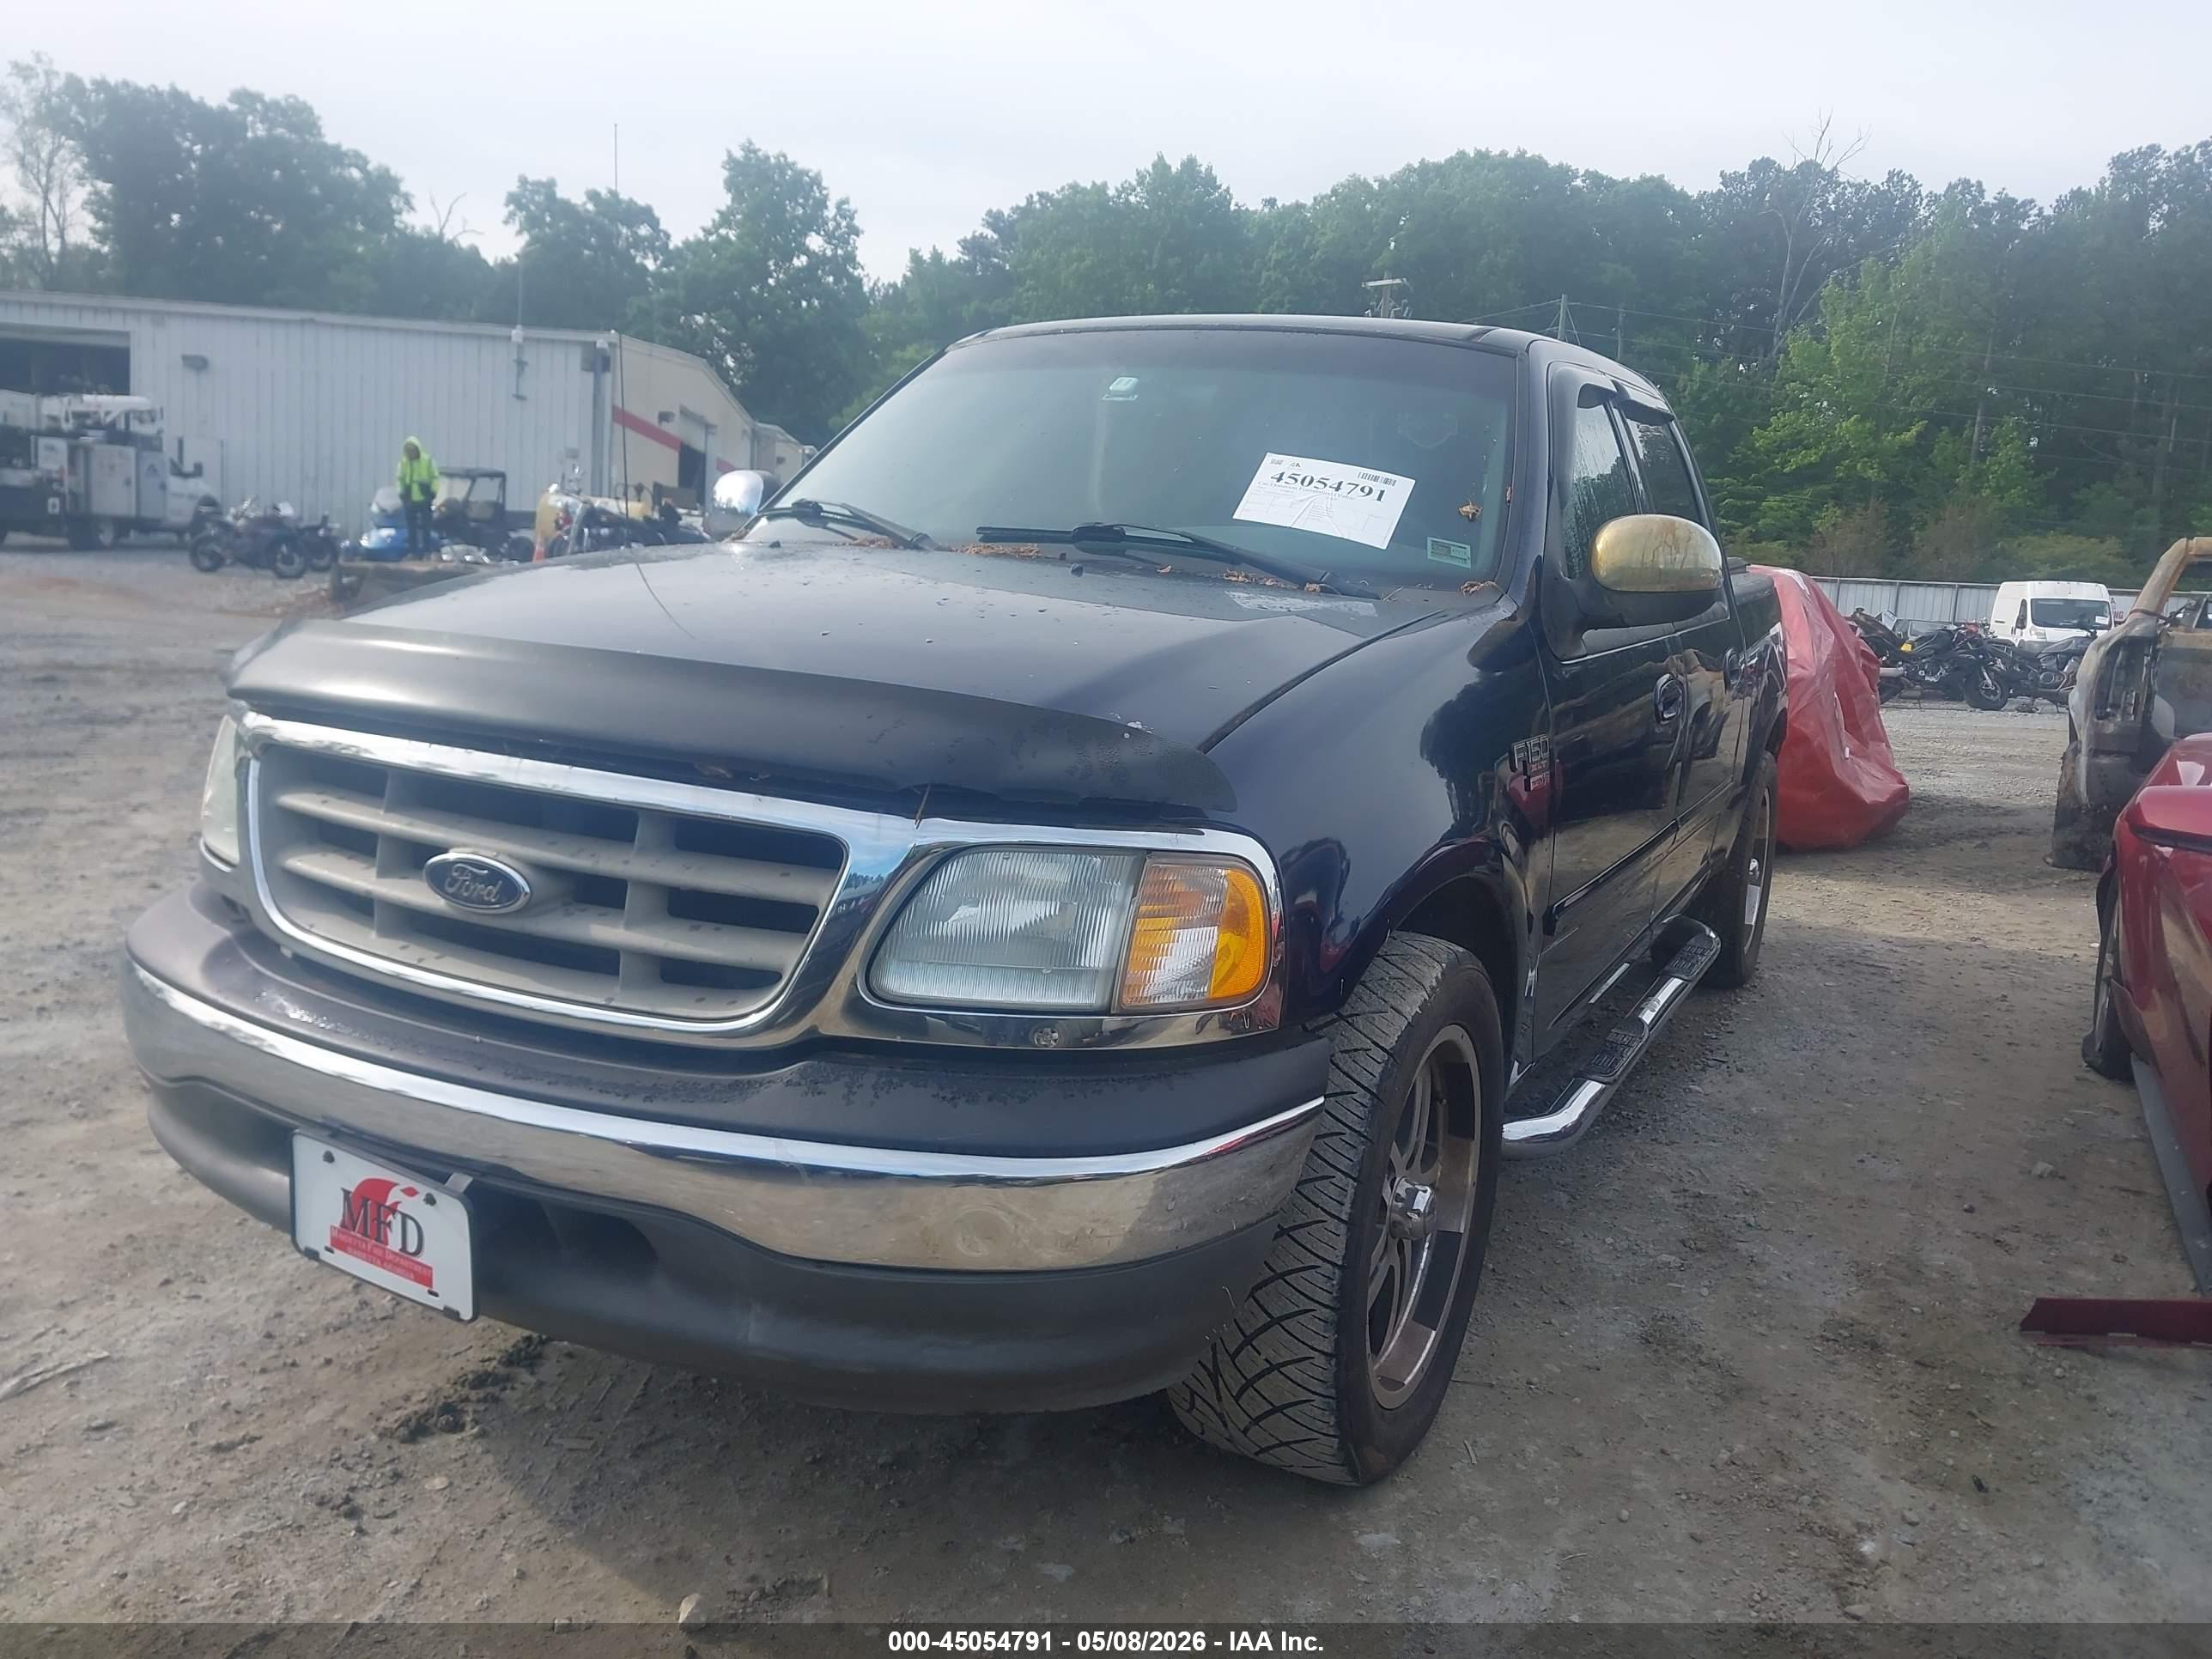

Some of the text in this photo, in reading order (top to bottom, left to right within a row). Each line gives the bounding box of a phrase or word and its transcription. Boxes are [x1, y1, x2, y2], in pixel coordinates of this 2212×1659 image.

[1270, 471, 1387, 502] 45054791
[445, 863, 502, 902] Ford
[339, 1188, 425, 1258] MFD
